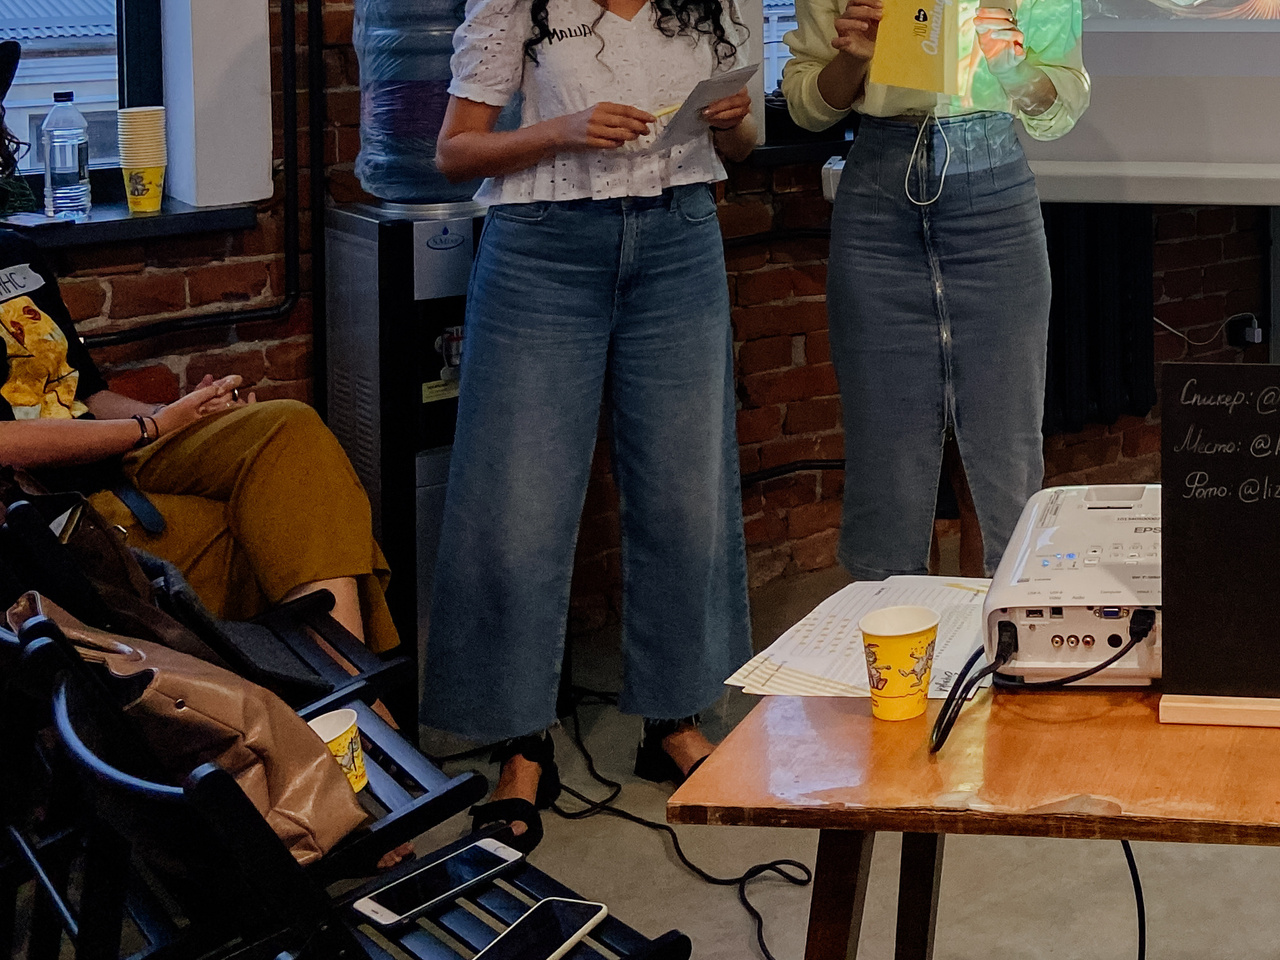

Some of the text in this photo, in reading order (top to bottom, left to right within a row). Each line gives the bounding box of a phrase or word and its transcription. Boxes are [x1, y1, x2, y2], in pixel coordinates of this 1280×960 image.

[1180, 378, 1254, 415] Спикер:
[1173, 424, 1242, 454] Место:
[1182, 471, 1233, 499] Фото:
